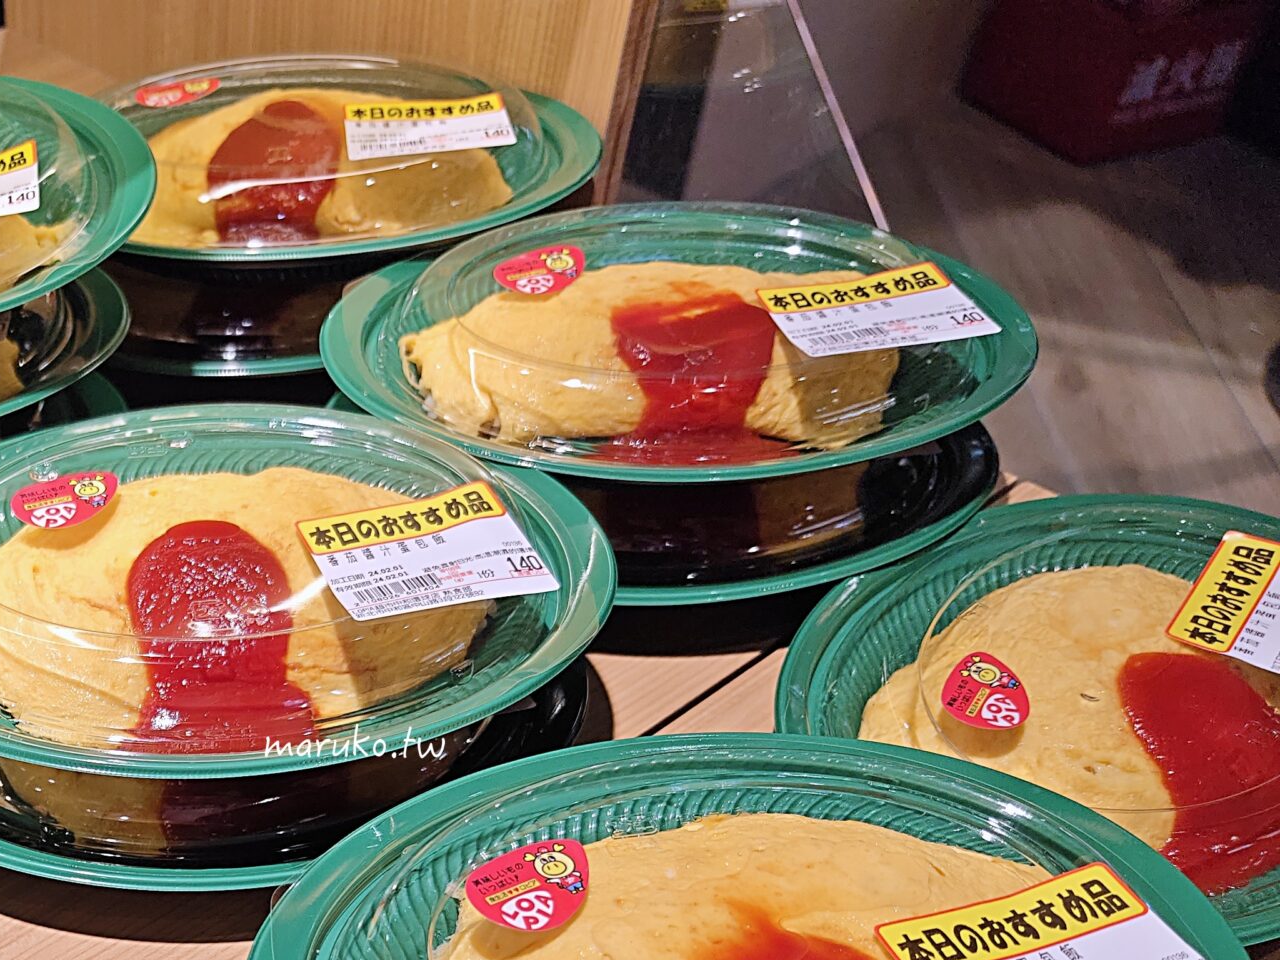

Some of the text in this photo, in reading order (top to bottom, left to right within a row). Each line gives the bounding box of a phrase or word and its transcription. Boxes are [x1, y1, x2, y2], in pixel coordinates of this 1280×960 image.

[352, 101, 494, 120] 本日のおすすめ品
[7, 191, 36, 205] 140
[768, 271, 938, 310] 本日のおすすめ品
[950, 312, 984, 326] 140
[309, 490, 494, 549] 本日のおすすめ品
[507, 555, 542, 572] 140
[1184, 545, 1275, 645] 本日のおすすめ品
